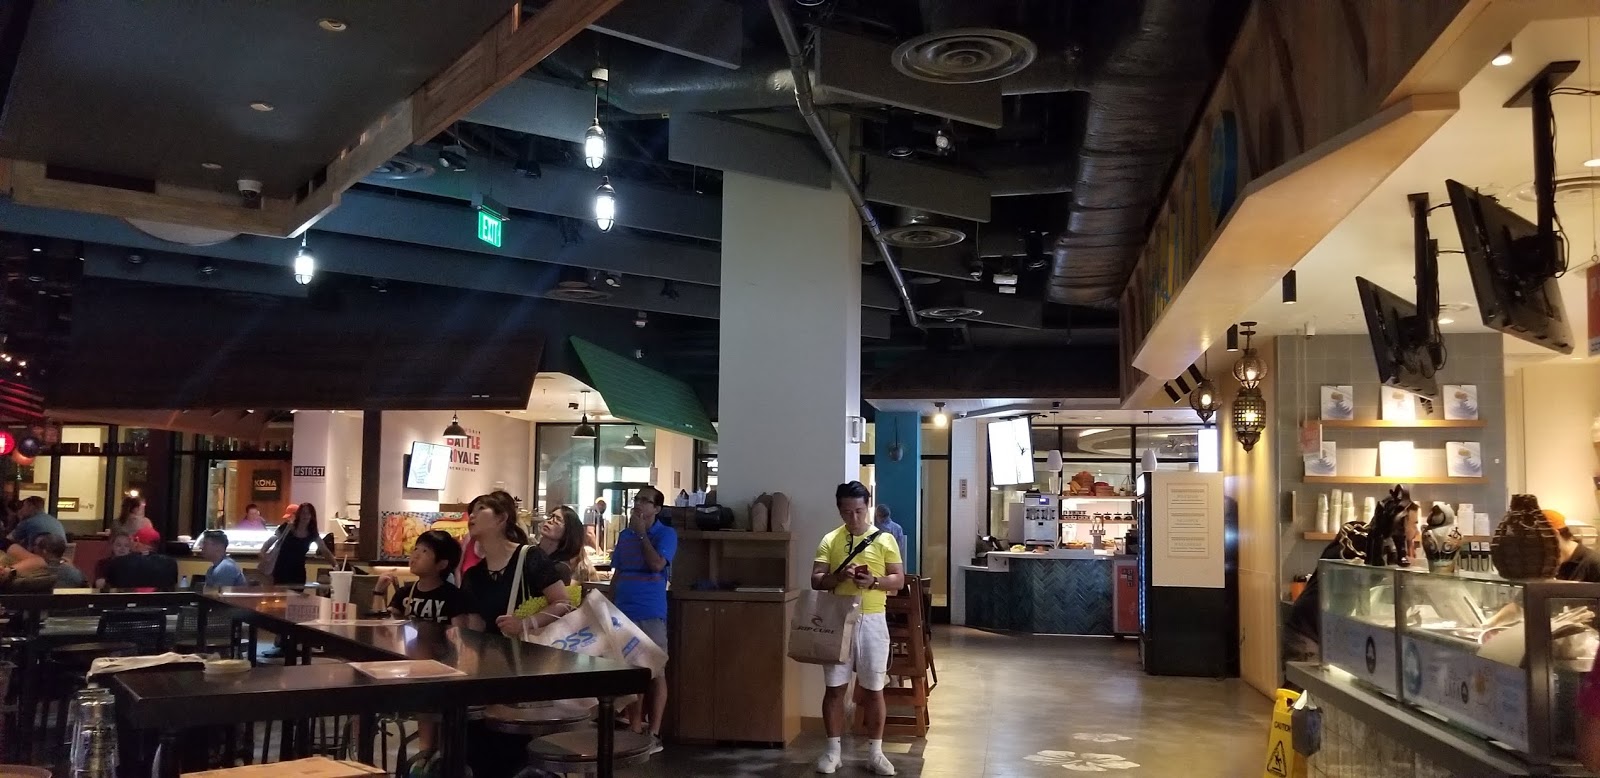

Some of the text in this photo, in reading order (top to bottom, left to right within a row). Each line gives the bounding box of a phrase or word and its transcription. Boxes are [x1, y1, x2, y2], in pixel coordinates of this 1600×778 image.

[482, 214, 500, 245] EXIT
[300, 467, 325, 476] STREET
[254, 479, 277, 487] KONA
[402, 597, 446, 616] STAY
[551, 626, 594, 650] OSS
